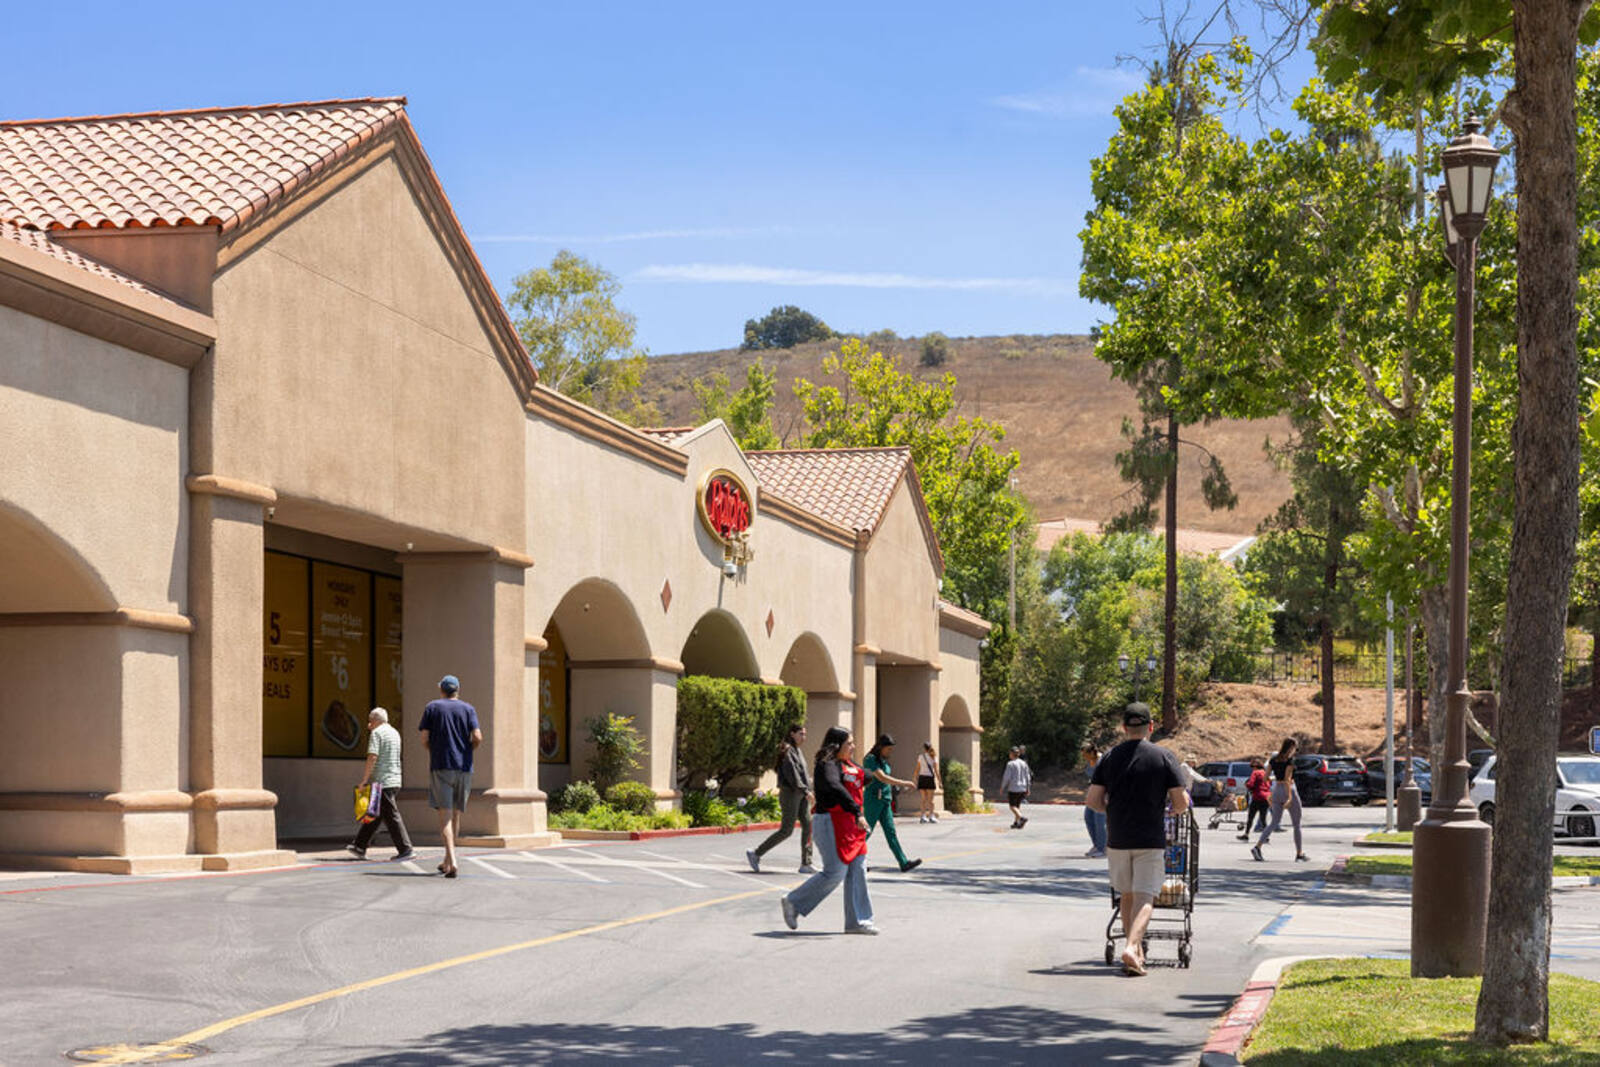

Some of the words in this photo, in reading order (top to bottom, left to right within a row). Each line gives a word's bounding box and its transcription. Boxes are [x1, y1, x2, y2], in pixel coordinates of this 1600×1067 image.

[270, 612, 281, 645] 5
[281, 658, 295, 672] OF
[331, 654, 349, 690] $6
